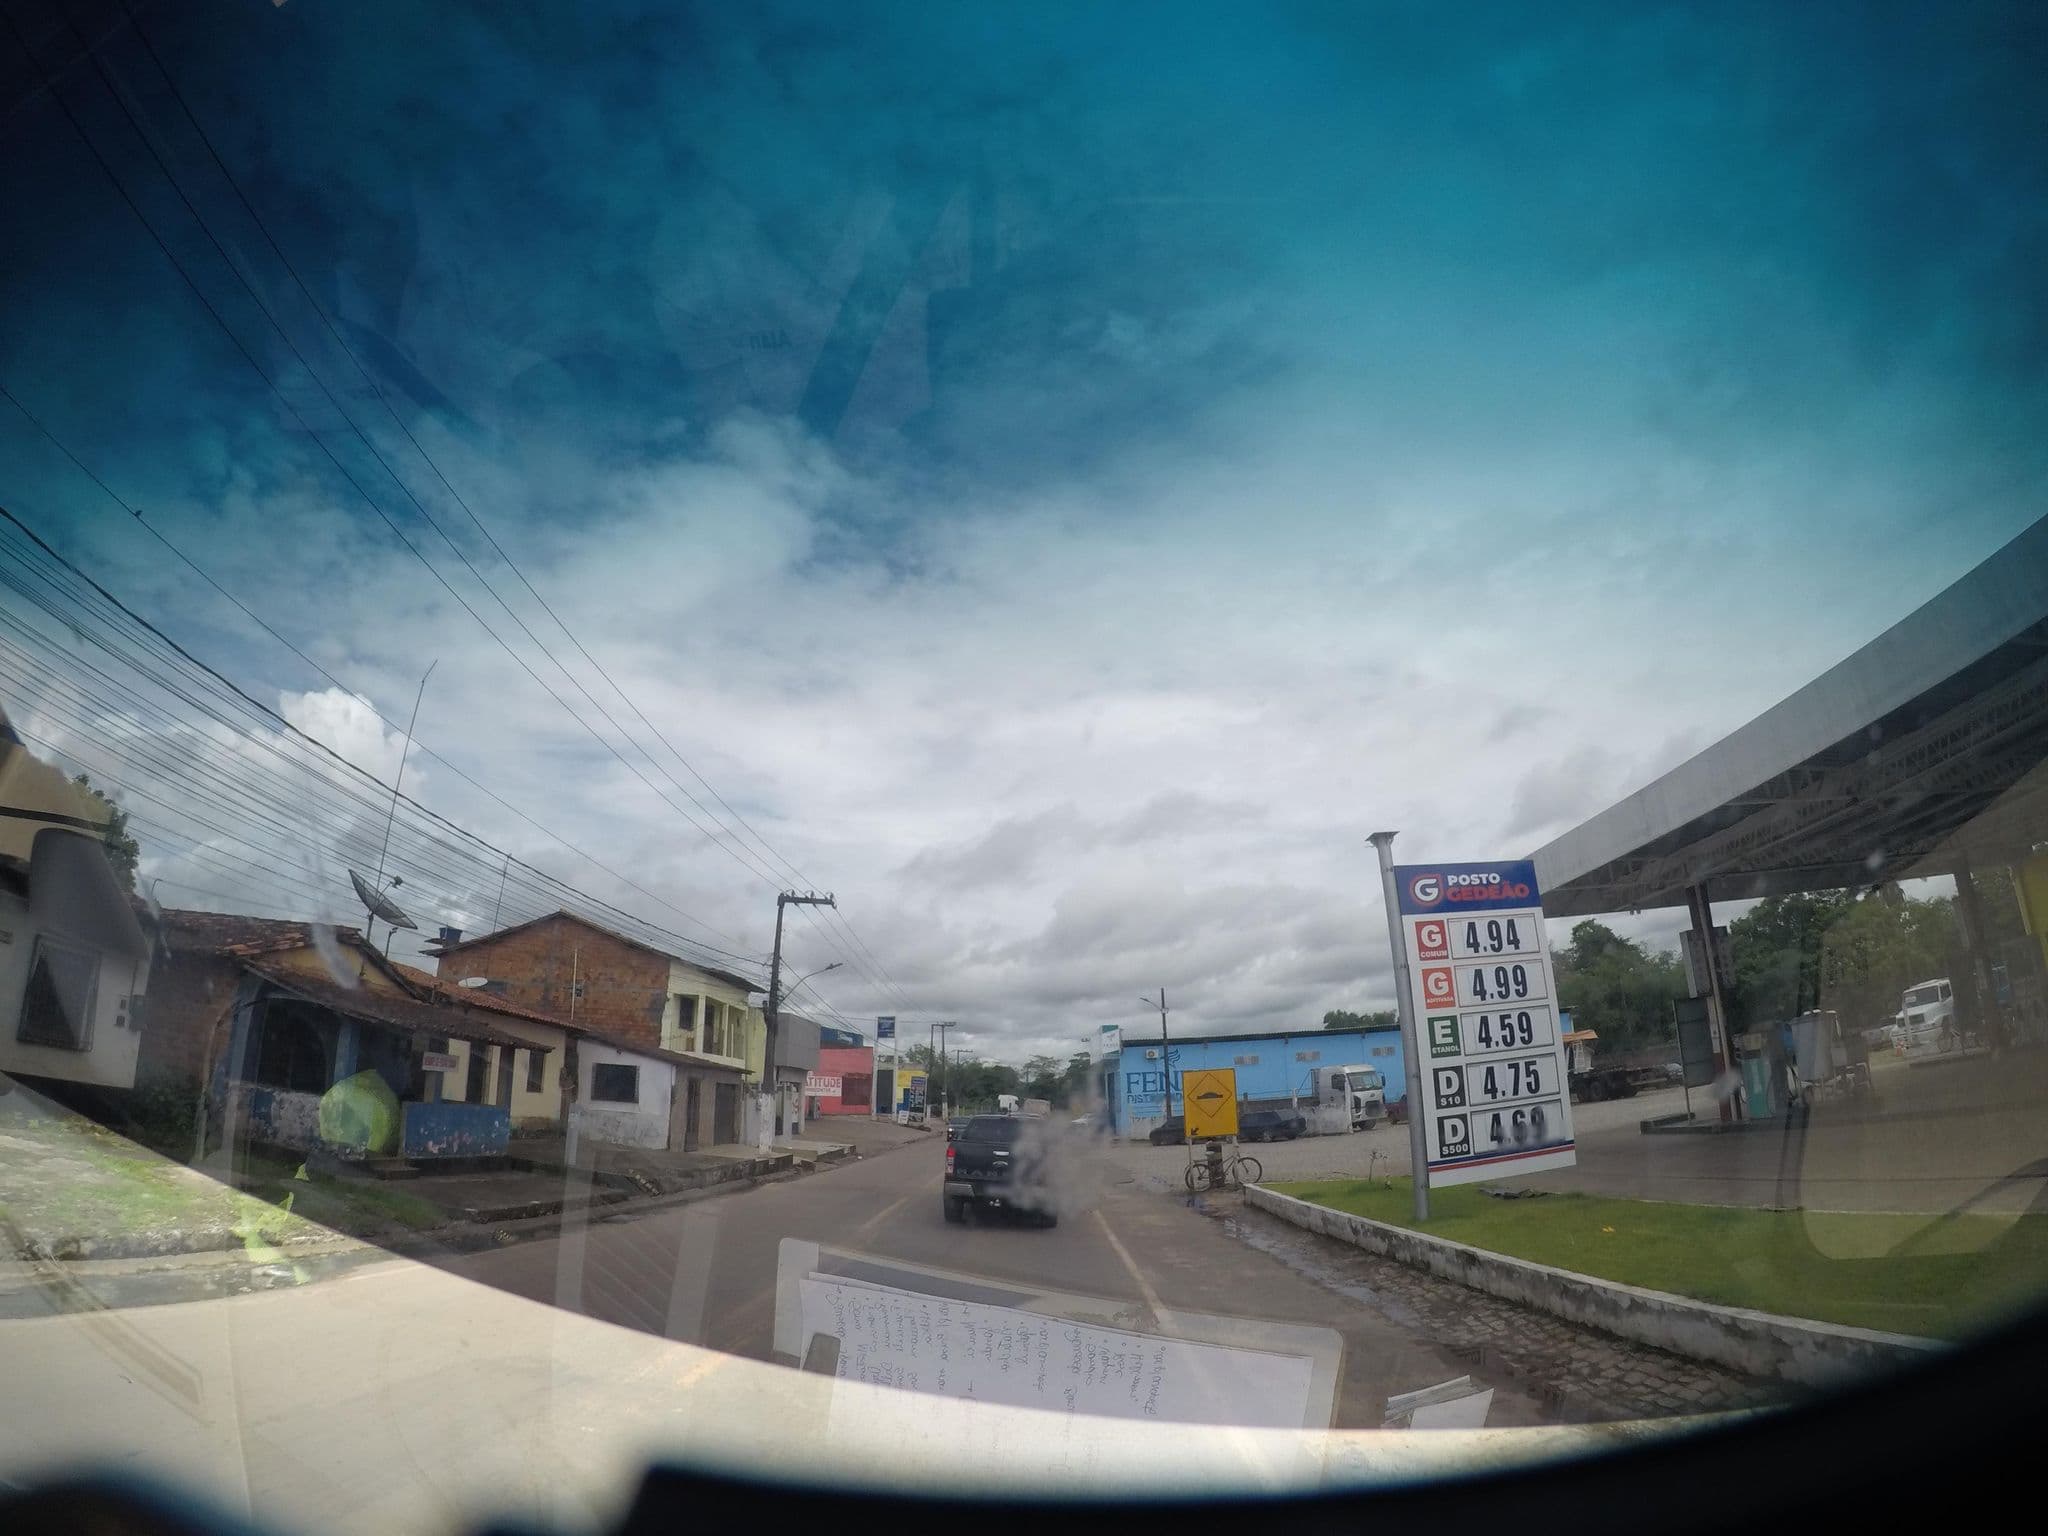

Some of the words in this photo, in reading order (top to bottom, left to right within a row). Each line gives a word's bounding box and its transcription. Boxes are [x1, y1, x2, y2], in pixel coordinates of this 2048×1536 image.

[1447, 873, 1501, 886] POSTO
[1421, 924, 1443, 948] G
[1466, 919, 1520, 953] 4.94
[1427, 971, 1449, 996] G
[1473, 965, 1528, 1001] 4.99
[1433, 1020, 1454, 1045] E
[1478, 1012, 1533, 1048] 4.59
[1432, 1045, 1460, 1054] ETANOL
[1126, 1070, 1184, 1094] FEN
[1438, 1070, 1460, 1096] D
[1484, 1060, 1540, 1100] 4.75
[1440, 1095, 1461, 1106] S10
[1443, 1118, 1465, 1145] D
[1442, 1143, 1469, 1155] S500
